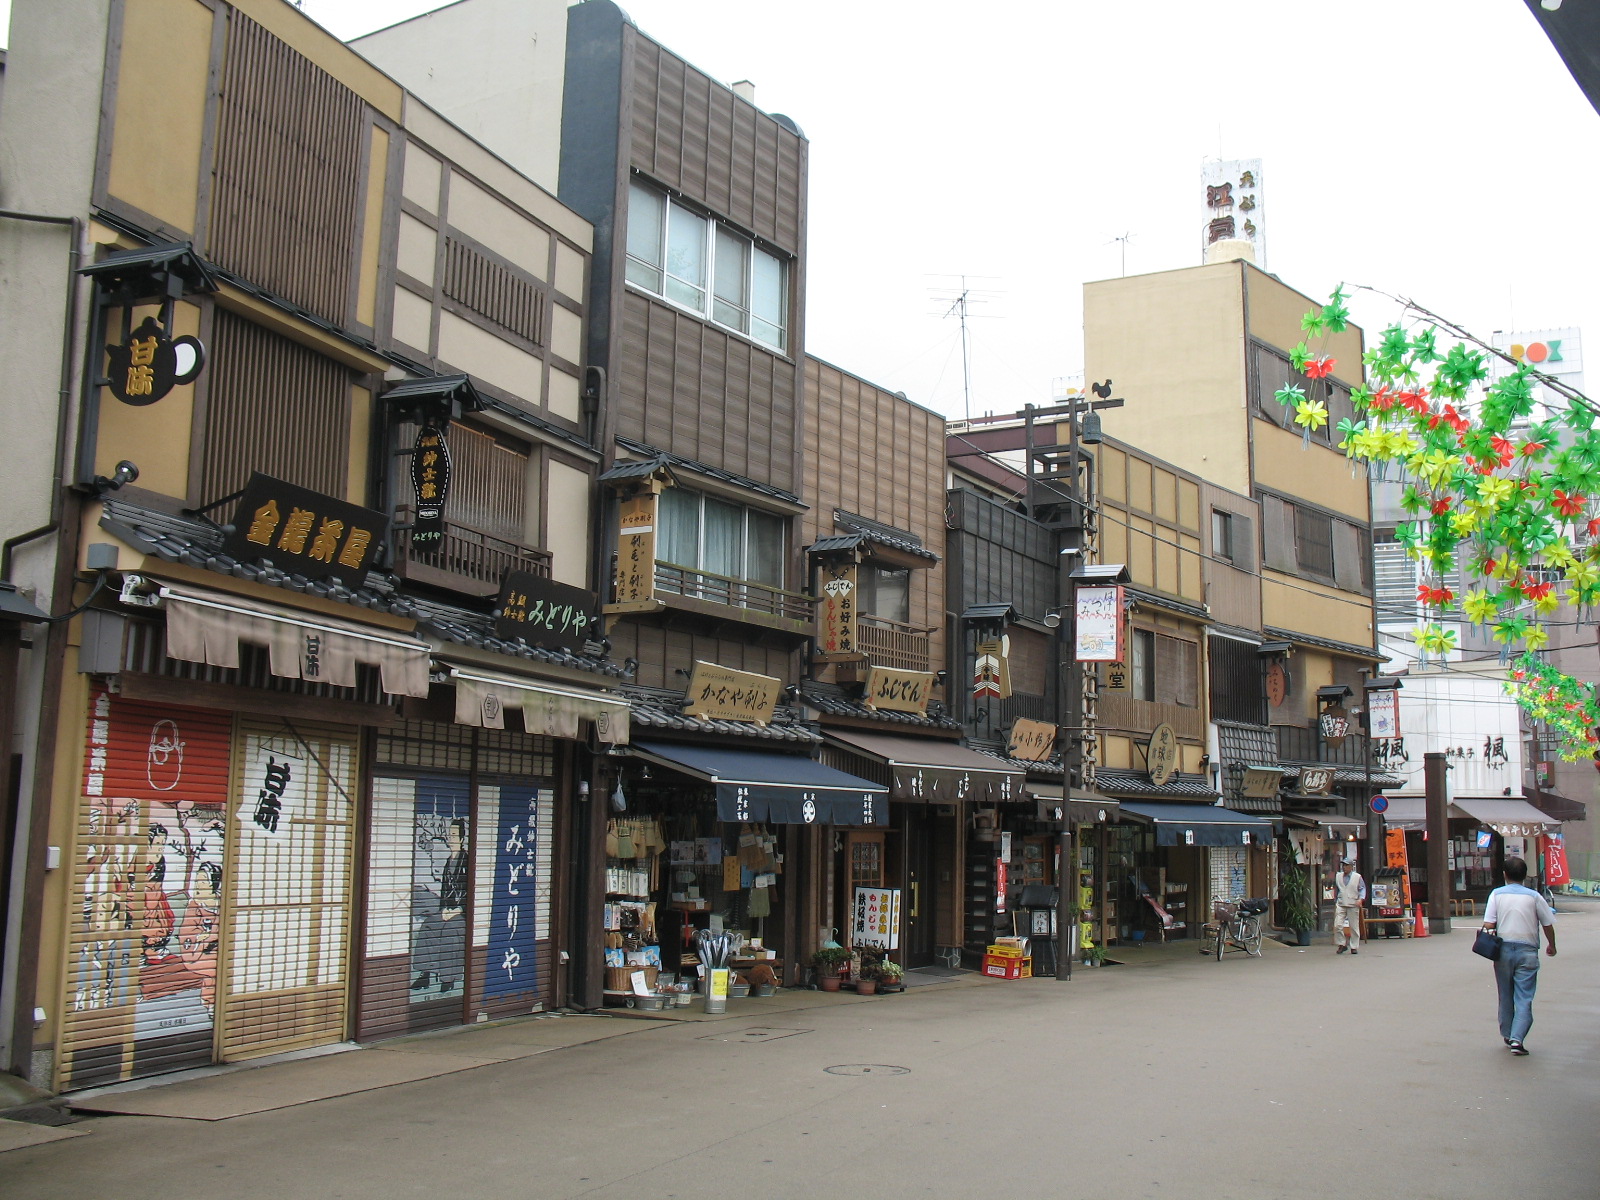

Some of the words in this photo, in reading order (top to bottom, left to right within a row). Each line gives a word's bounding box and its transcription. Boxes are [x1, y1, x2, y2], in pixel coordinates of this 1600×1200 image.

[126, 336, 158, 396] 甘味
[246, 499, 372, 570] 金龍茶屋
[412, 531, 441, 541] みどりや
[826, 581, 852, 592] ふじでん
[528, 600, 587, 636] みどりや
[826, 599, 837, 651] もんじゃ焼
[839, 598, 851, 650] お好み焼
[877, 677, 921, 703] ふじでん
[1380, 737, 1409, 763] 楓
[1445, 745, 1475, 759] 和菓子
[1484, 735, 1508, 763] 楓
[502, 824, 525, 982] みどりや
[869, 893, 877, 931] もんじゃ
